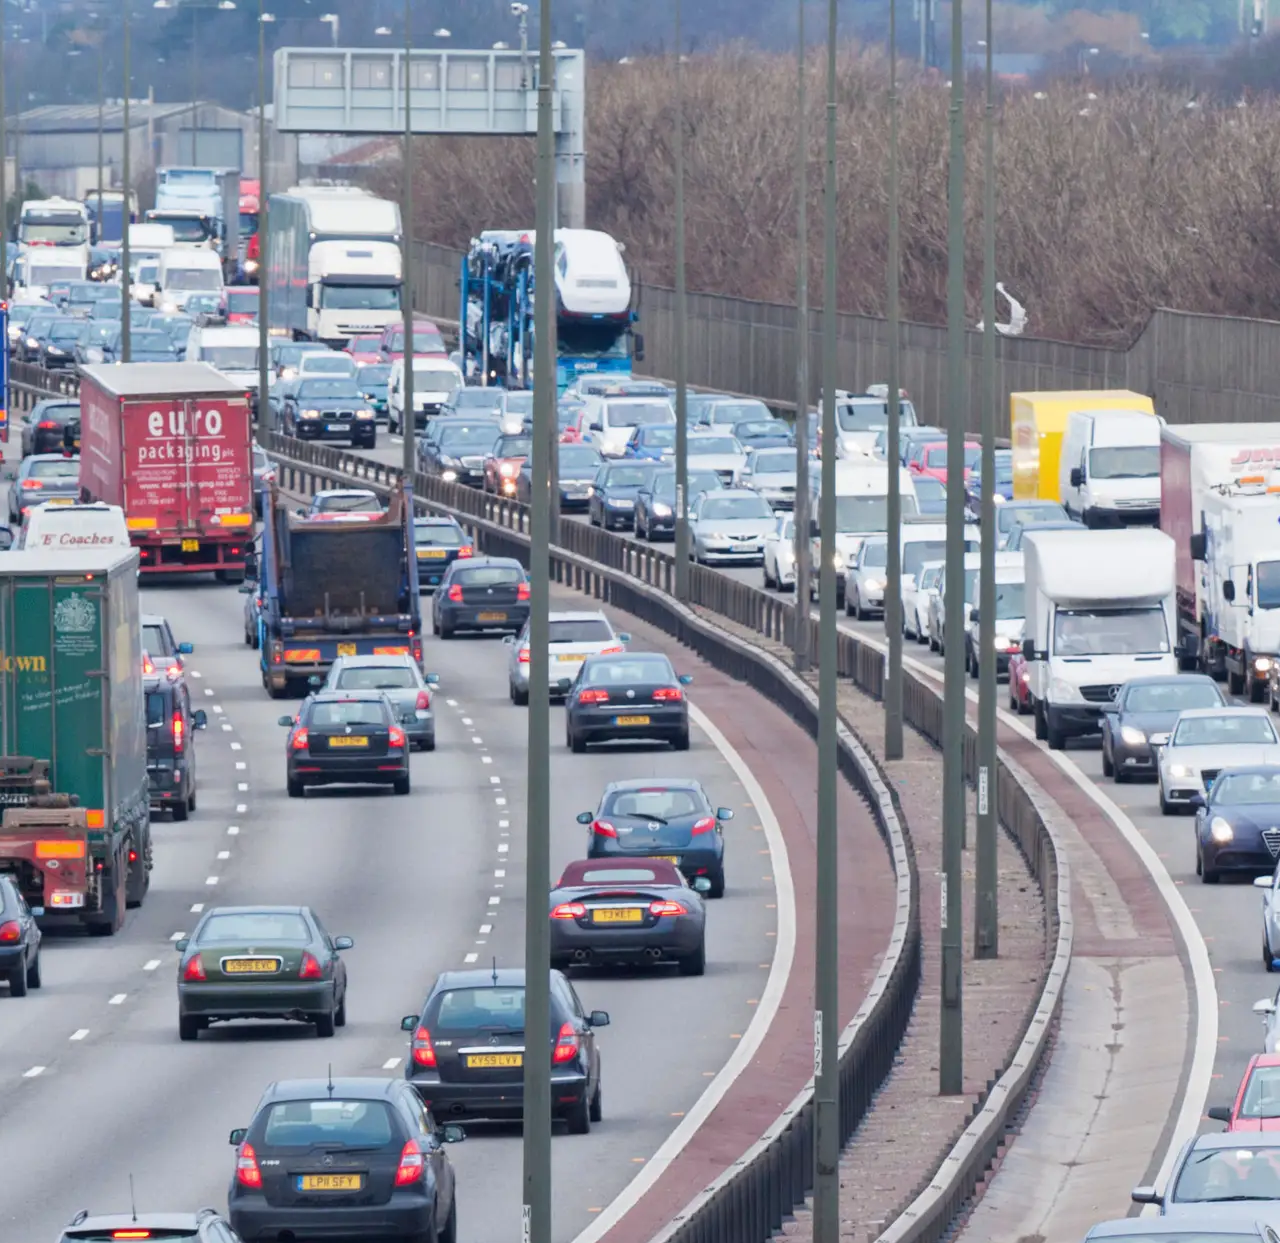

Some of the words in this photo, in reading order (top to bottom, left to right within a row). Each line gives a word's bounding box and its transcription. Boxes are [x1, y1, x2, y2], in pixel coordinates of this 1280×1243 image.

[148, 409, 222, 436] euro
[138, 441, 222, 463] packaging
[59, 532, 114, 545] Coaches
